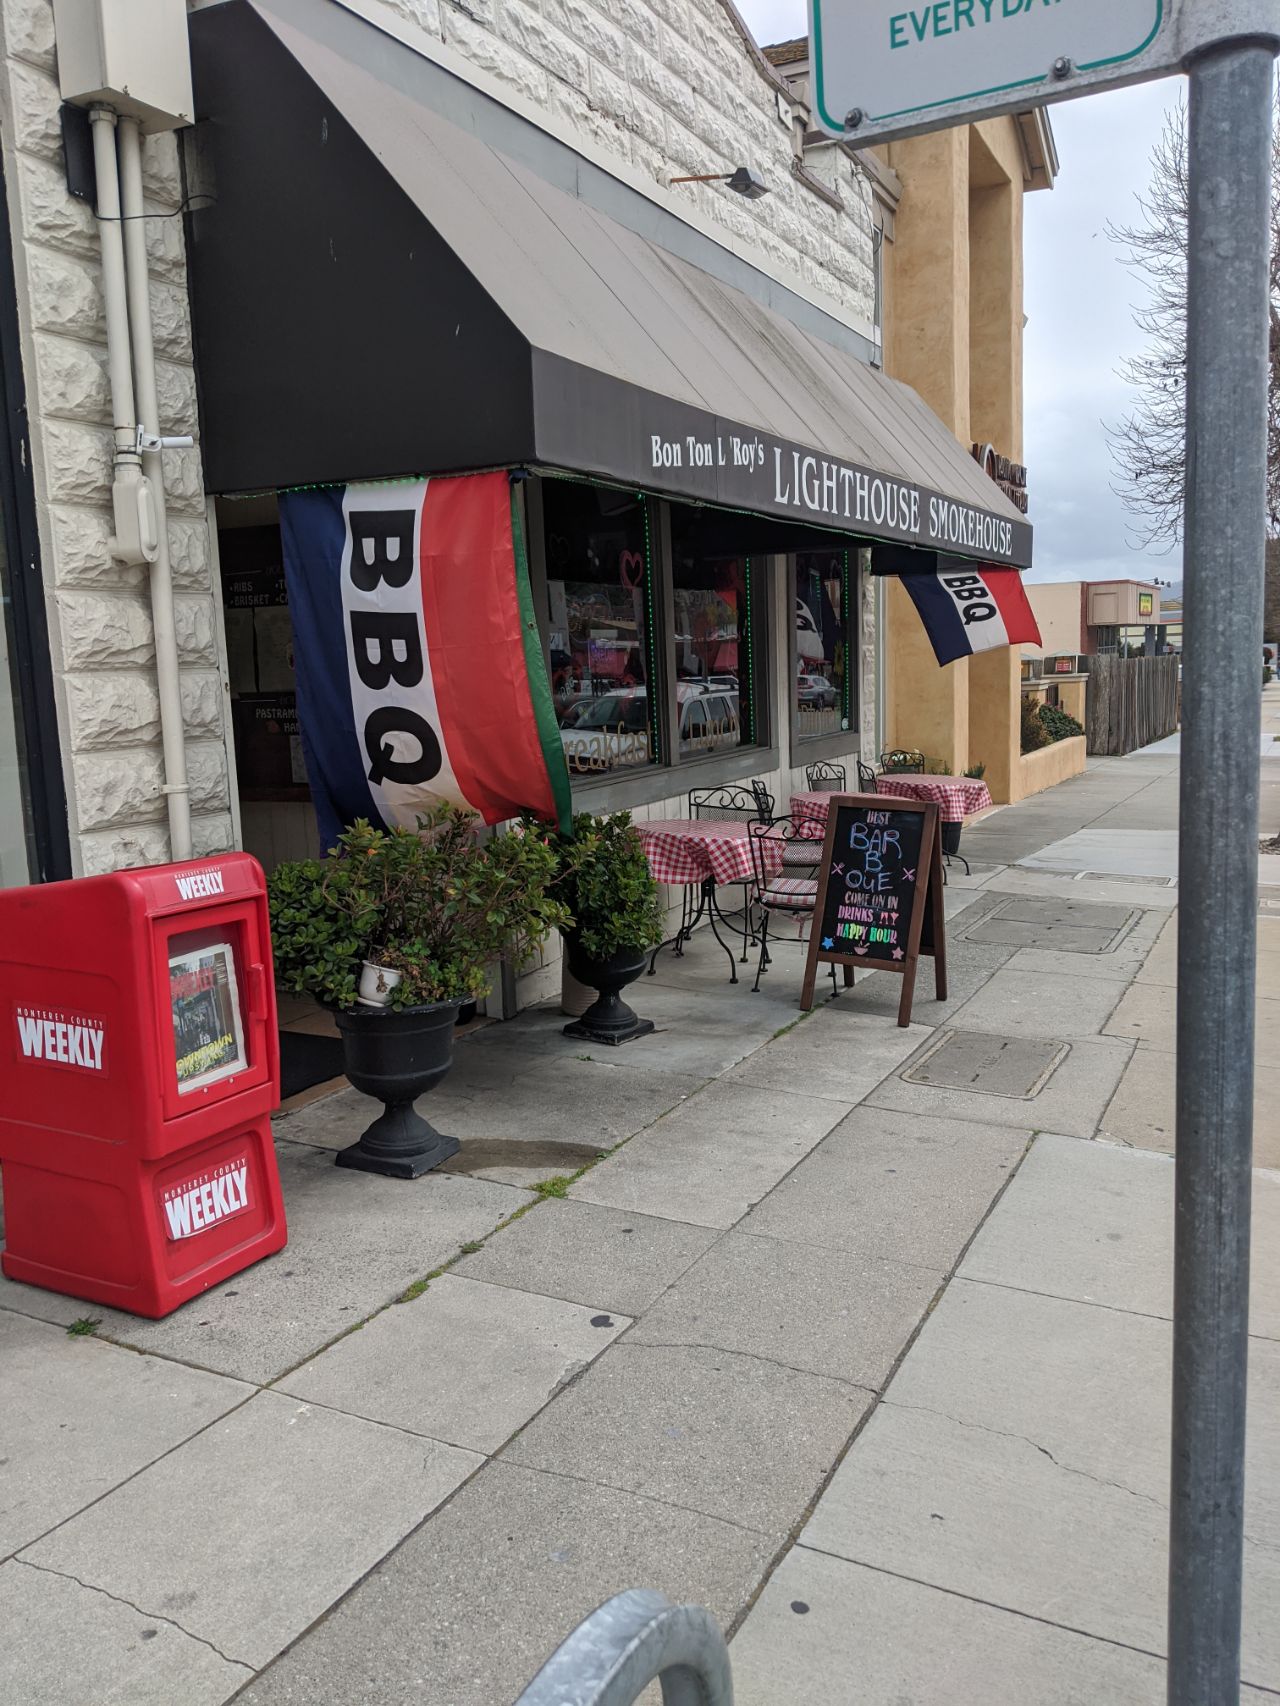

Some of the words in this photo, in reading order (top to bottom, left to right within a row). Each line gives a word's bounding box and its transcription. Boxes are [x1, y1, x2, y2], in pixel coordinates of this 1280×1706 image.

[889, 0, 1062, 49] EVERYD
[651, 435, 682, 467] Bon
[686, 436, 713, 466] Ton
[718, 437, 727, 466] L
[773, 447, 920, 534] LIGHTHOUSE
[929, 496, 1013, 556] SMOKEHOUSE
[233, 581, 254, 592] RIBS
[234, 594, 270, 606] BRISKET
[942, 575, 997, 626] BBQ
[348, 509, 442, 786] BBQ
[565, 720, 656, 773] reakfast
[867, 810, 891, 825] BEST
[850, 822, 902, 859] BAR
[866, 850, 883, 872] B
[175, 871, 225, 900] WEEKLY
[845, 891, 870, 906] COME
[872, 894, 885, 908] ON
[888, 896, 899, 909] IN
[838, 905, 873, 922] DRINKS
[836, 923, 868, 940] HAPPY
[869, 926, 897, 944] HOUR
[17, 1007, 65, 1022] MONTEREY
[70, 1016, 103, 1029] COUNTY
[17, 1016, 104, 1070] WEEKLY
[164, 1174, 209, 1202] MONTEREY
[214, 1158, 247, 1178] COUNTY
[164, 1166, 248, 1240] WEEKLY
